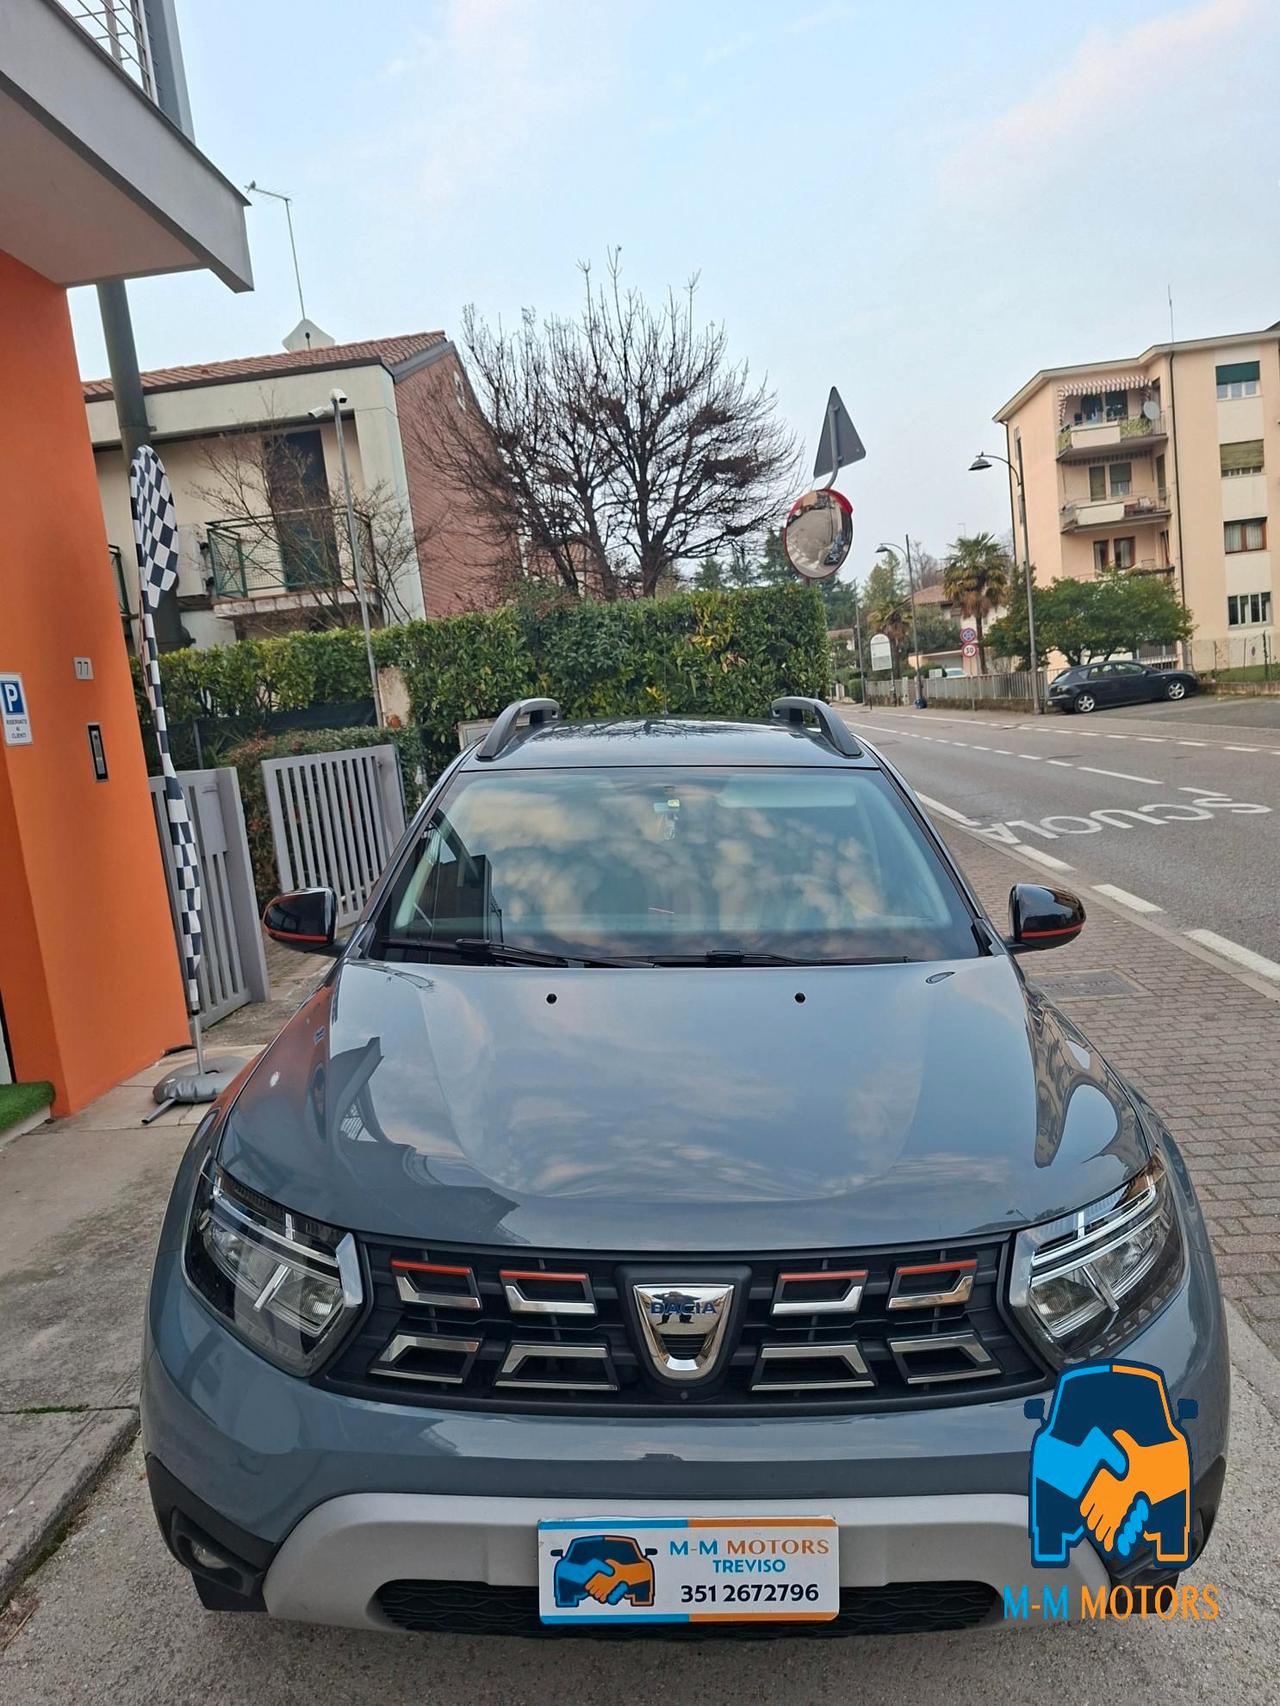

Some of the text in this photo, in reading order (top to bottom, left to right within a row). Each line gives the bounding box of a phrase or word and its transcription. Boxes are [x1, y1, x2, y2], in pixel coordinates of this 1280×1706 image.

[77, 661, 89, 675] 77
[4, 684, 18, 711] P
[972, 797, 1273, 844] SCUOLA
[650, 1302, 717, 1314] DACIA
[670, 1540, 829, 1555] M-M MOTORS
[713, 1559, 786, 1573] TREVISO
[680, 1583, 820, 1603] 351 2672796
